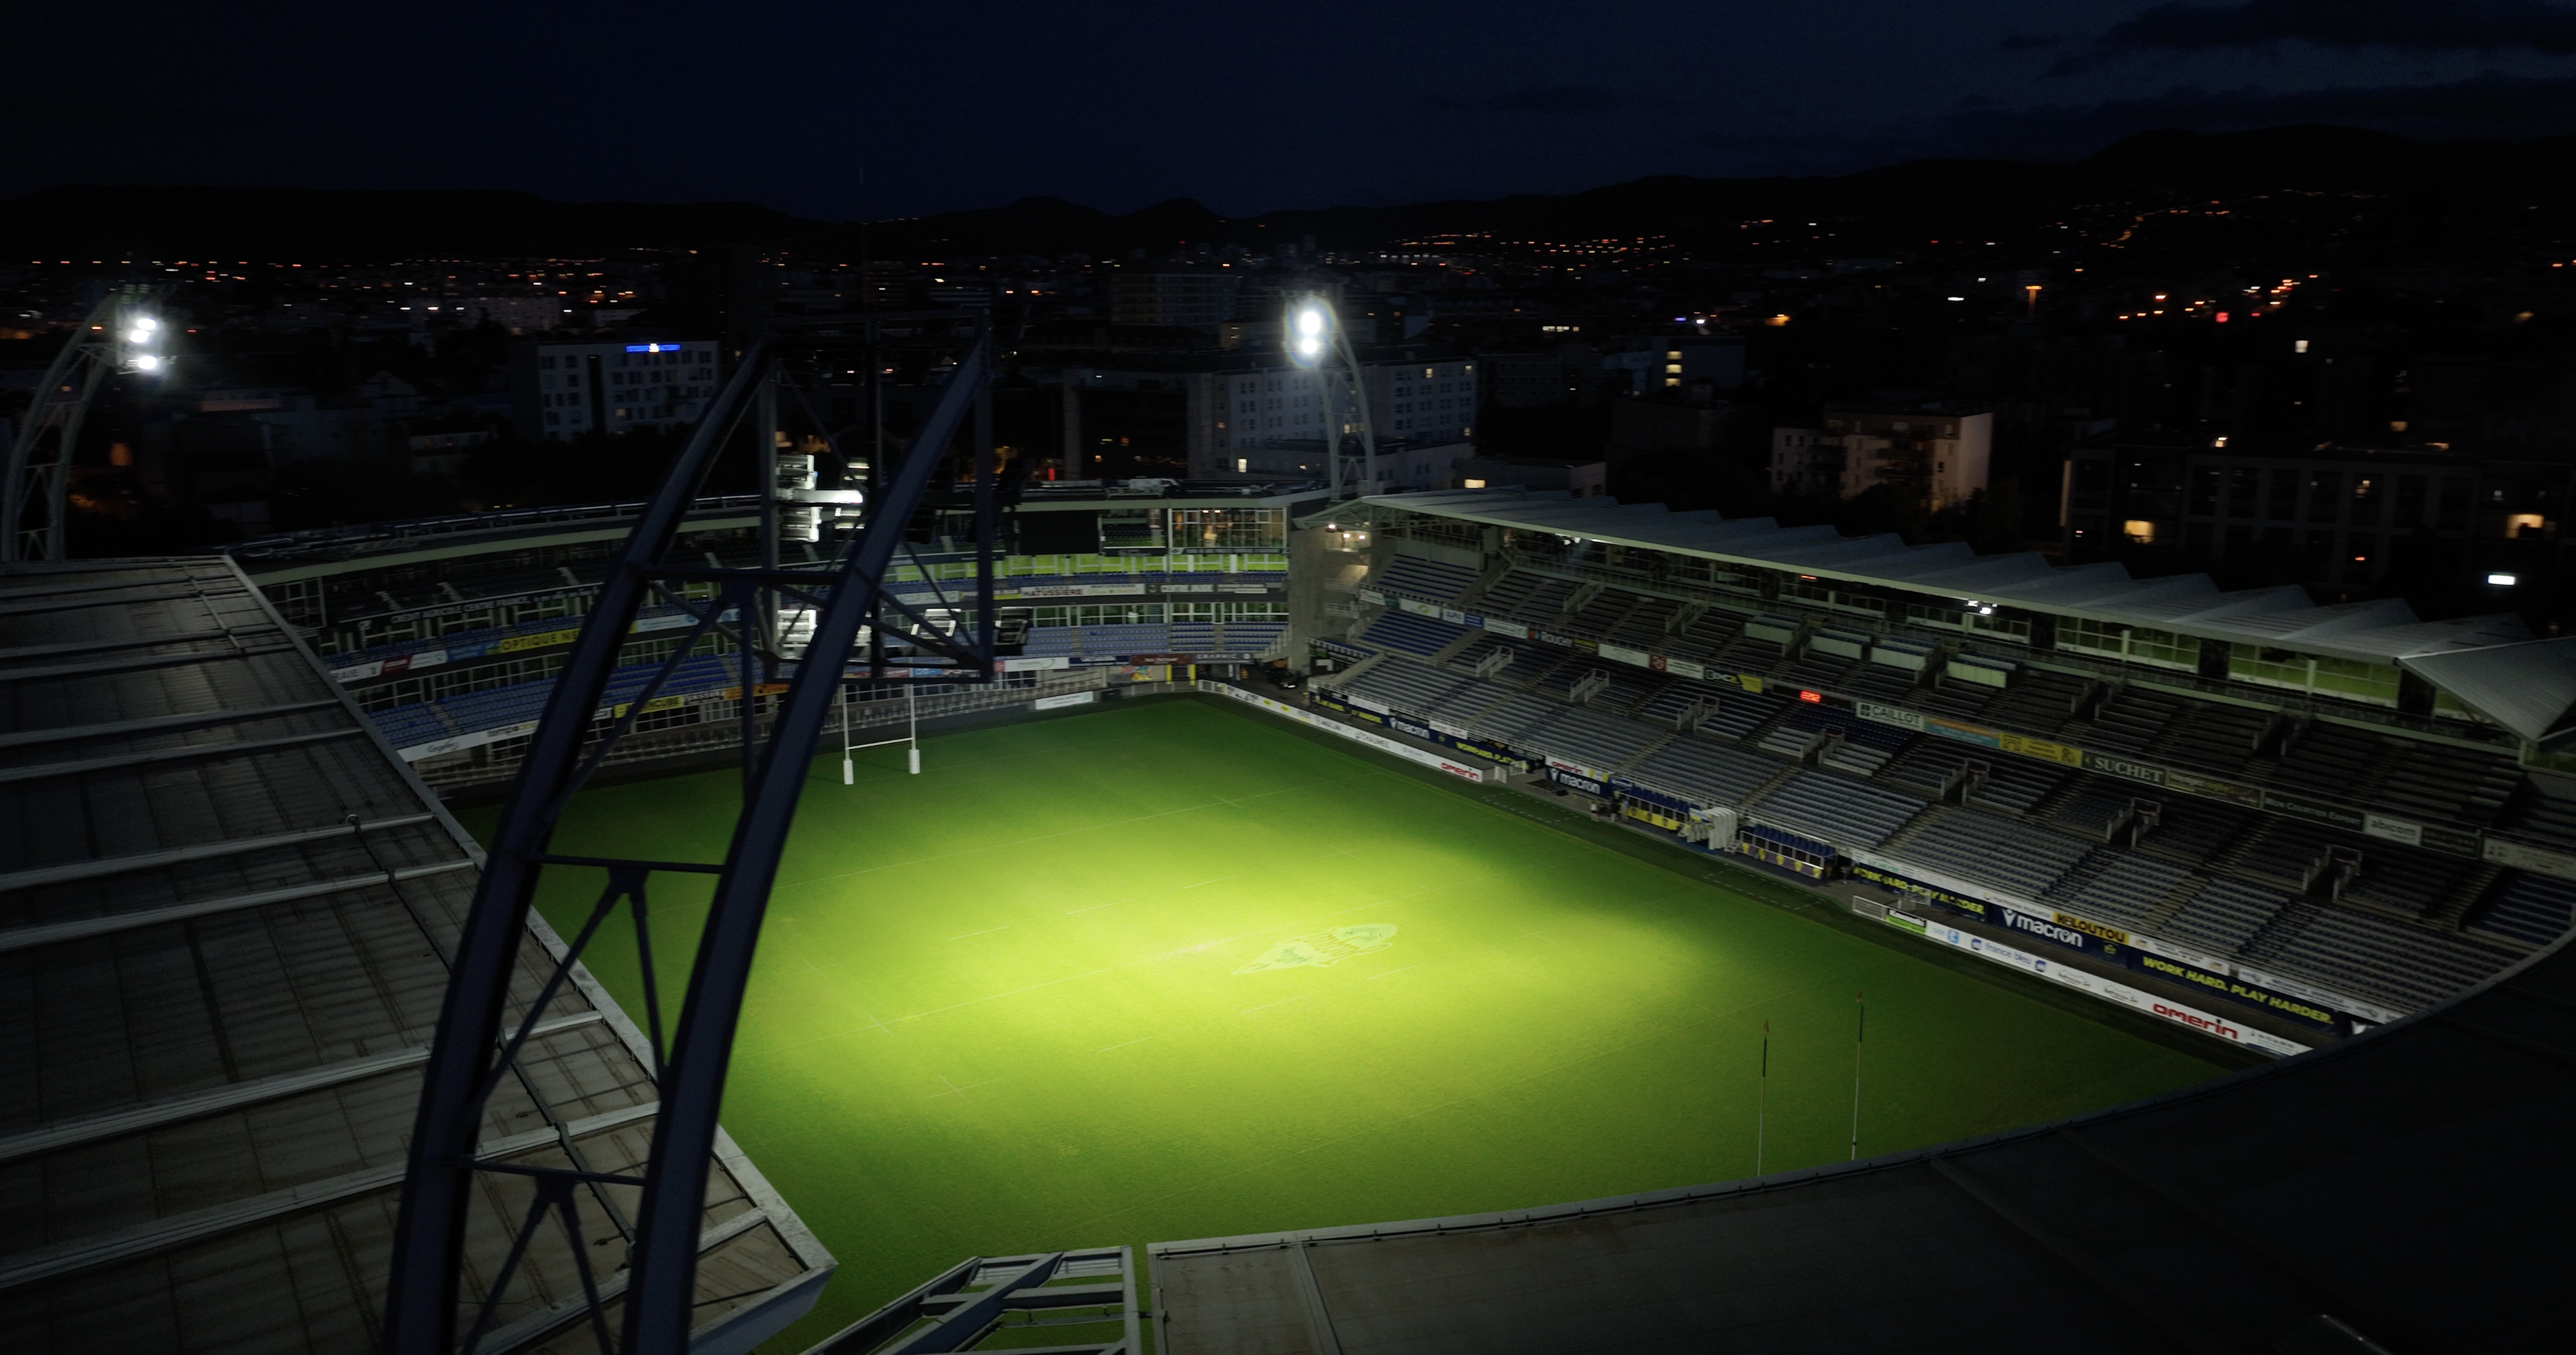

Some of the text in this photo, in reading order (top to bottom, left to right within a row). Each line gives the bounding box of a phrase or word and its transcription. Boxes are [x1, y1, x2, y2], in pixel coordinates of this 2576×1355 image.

[502, 633, 557, 651] OPTIQUE
[1872, 706, 1921, 726] CAILLOT
[1396, 720, 1430, 740] macron
[1440, 762, 1479, 780] omerin
[2094, 756, 2164, 783] SUCHET
[1560, 772, 1601, 795] macron
[2016, 914, 2083, 947] macron
[1985, 942, 2033, 965] france bleu
[2142, 956, 2334, 1025] WORK HARD. PLAY HARDER.
[2152, 1003, 2239, 1040] omerin
